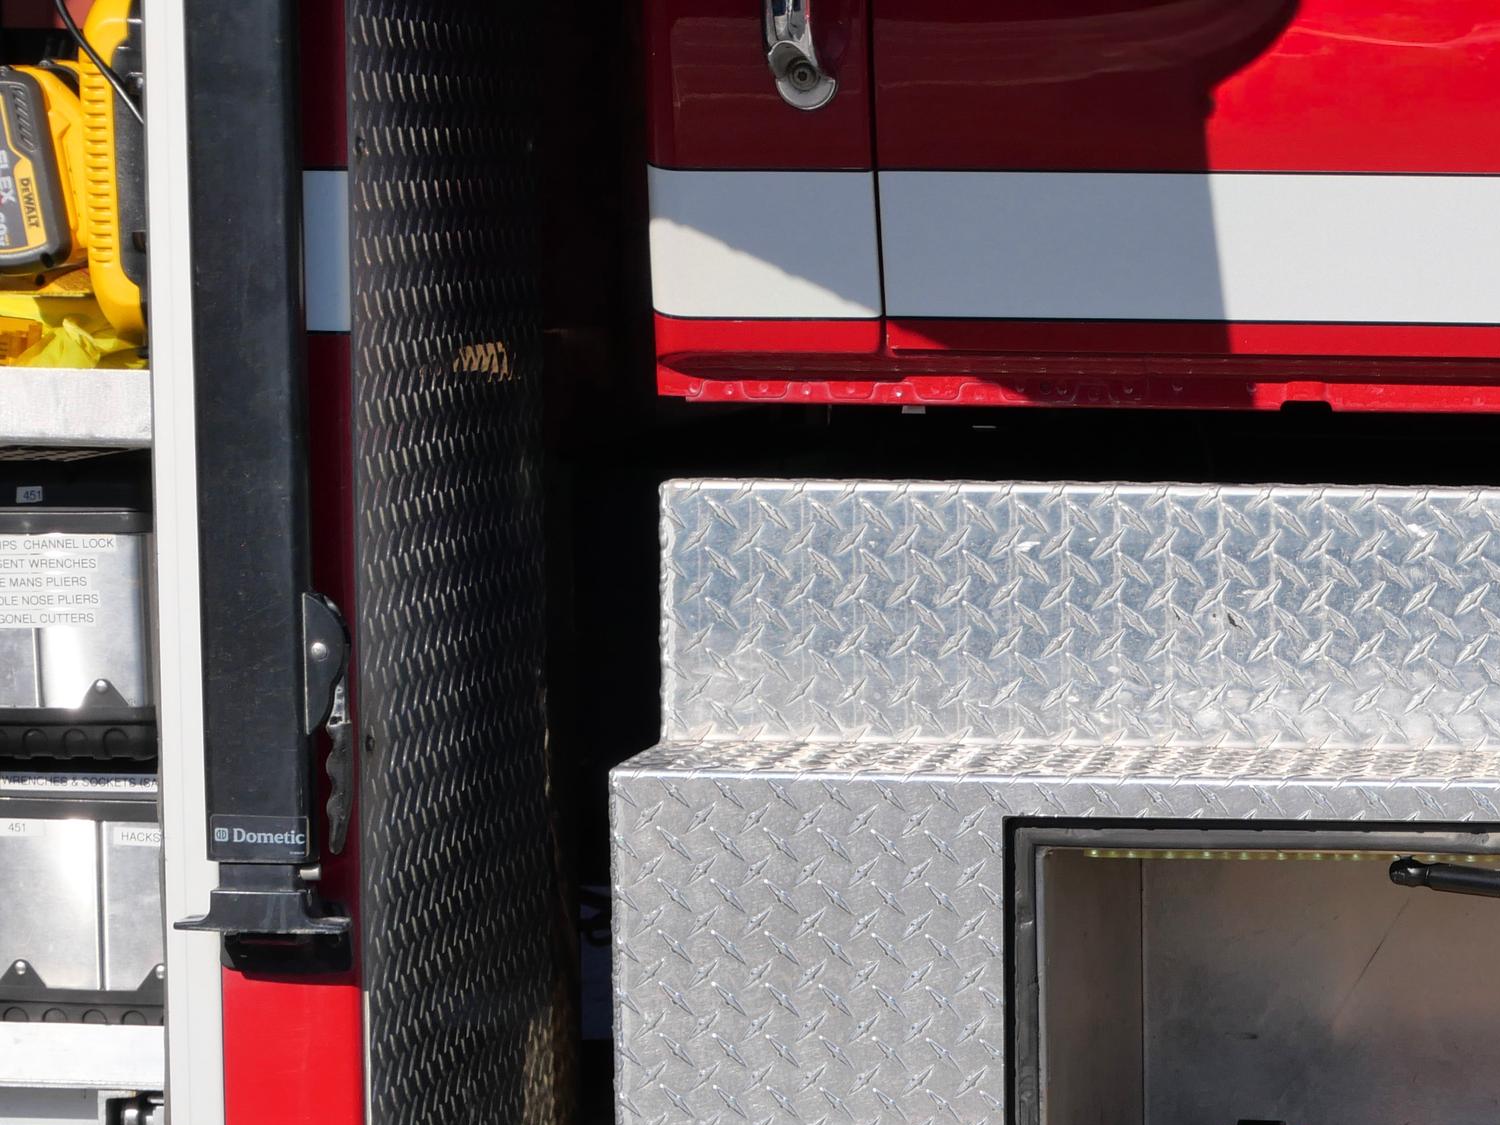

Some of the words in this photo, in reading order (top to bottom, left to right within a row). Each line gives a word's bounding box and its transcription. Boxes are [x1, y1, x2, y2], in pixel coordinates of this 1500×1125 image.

[23, 490, 41, 500] 451
[23, 539, 79, 550] CHANNEL
[82, 538, 114, 549] LOCK
[28, 558, 97, 569] WRENCHES
[9, 577, 42, 587] MANS
[46, 576, 88, 587] PLIERS
[22, 595, 54, 605] NOSE
[58, 594, 99, 605] PLIERS
[39, 613, 95, 623] CUTTERS
[1, 776, 68, 786] WRENCHES
[81, 777, 136, 787] SOCKETS
[8, 823, 26, 832] 451
[232, 827, 305, 845] Dometic
